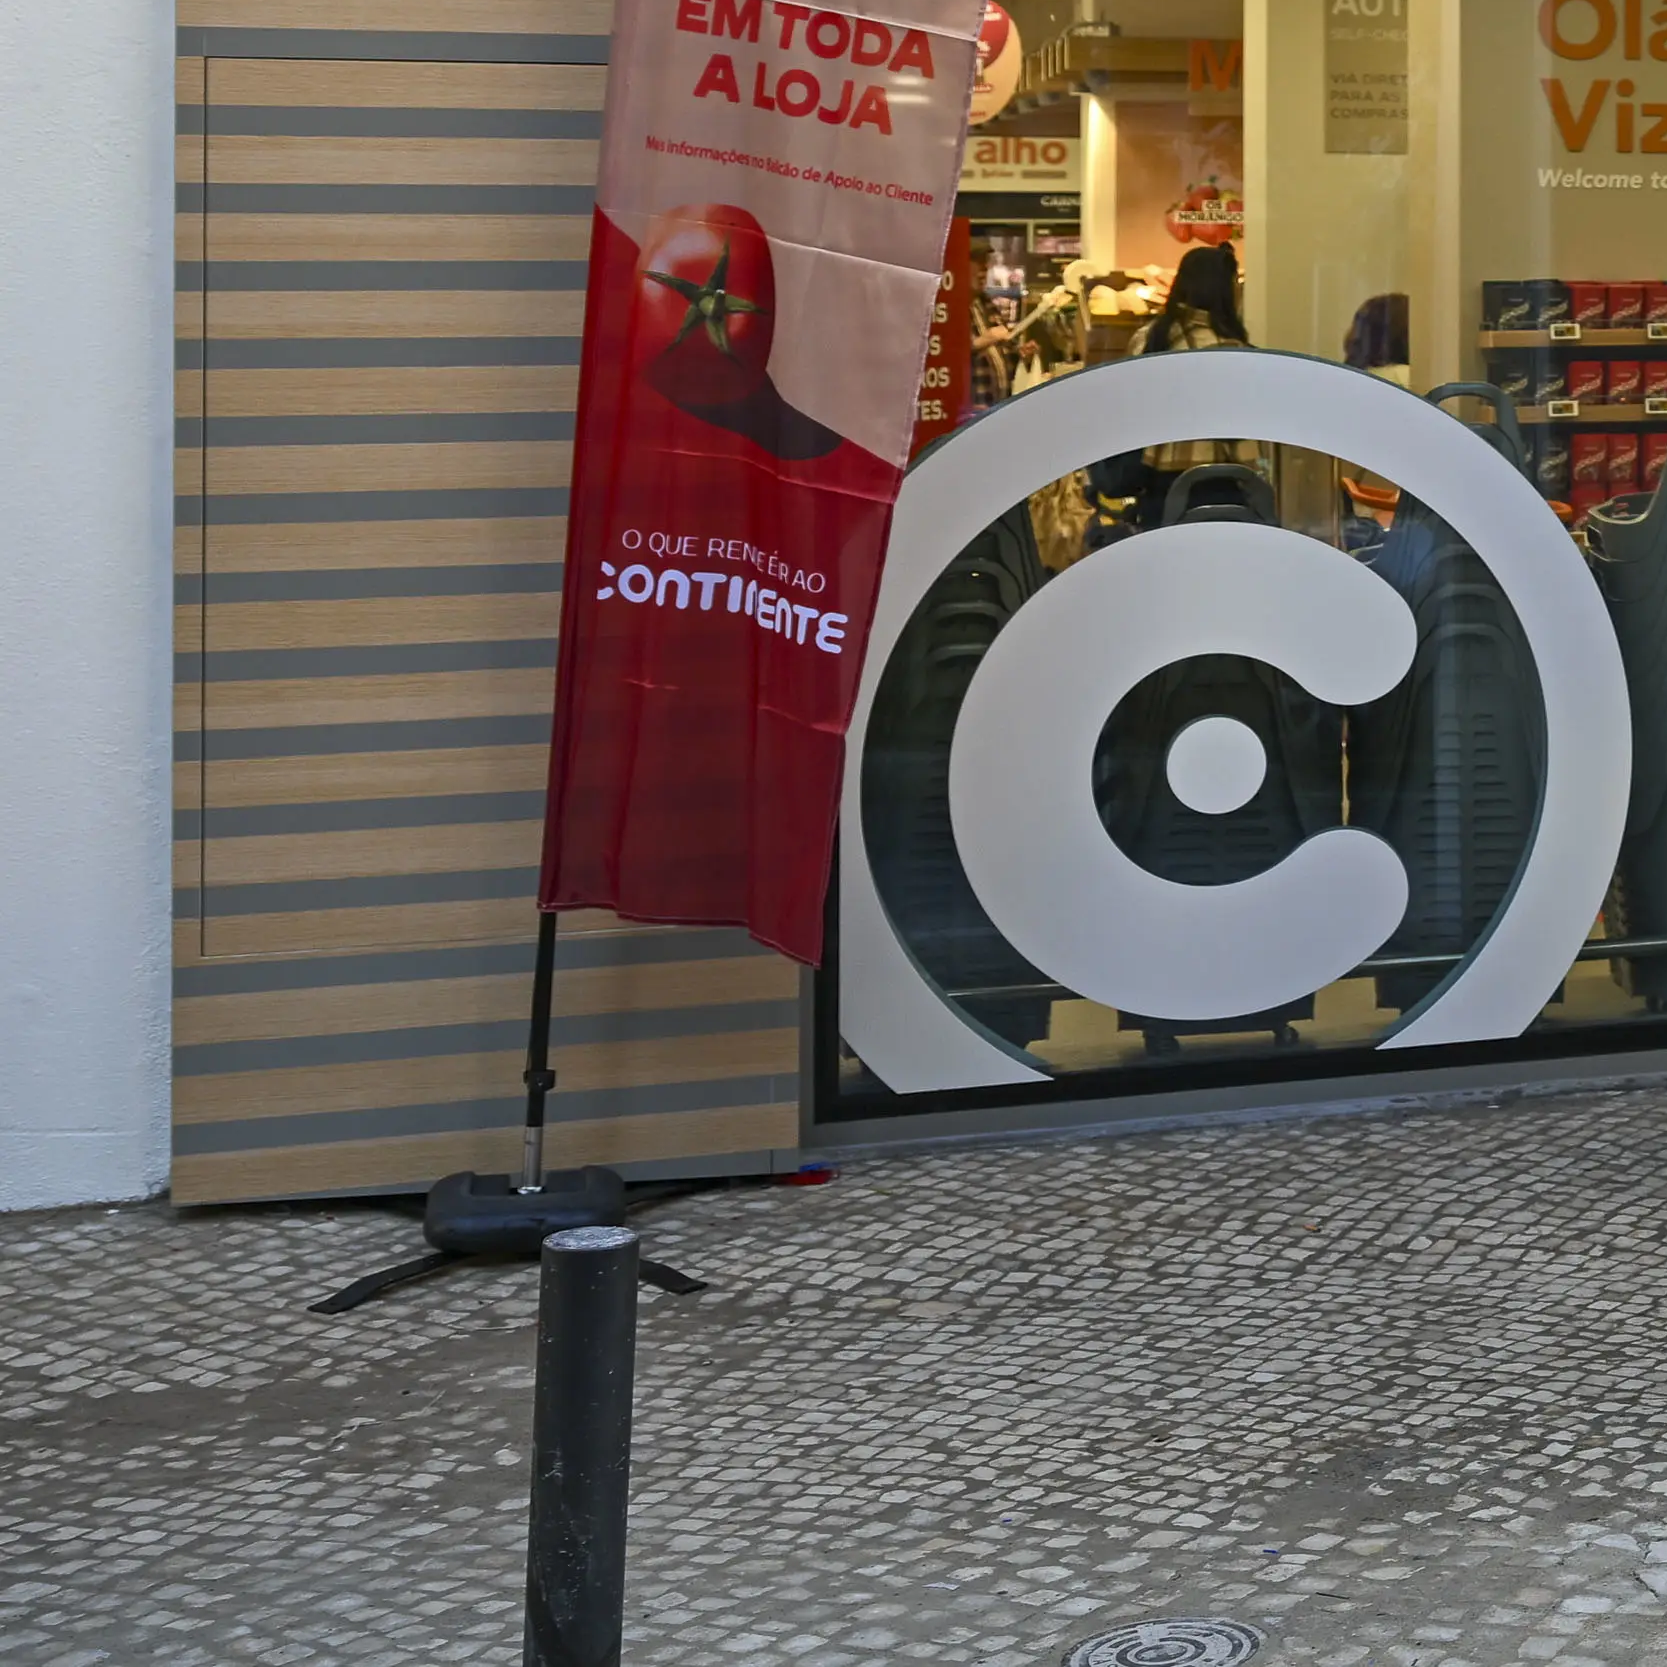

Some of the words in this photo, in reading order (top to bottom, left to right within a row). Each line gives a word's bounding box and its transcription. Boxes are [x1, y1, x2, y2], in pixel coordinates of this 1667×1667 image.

[774, 0, 936, 81] TODA
[692, 54, 741, 104] A
[752, 61, 894, 137] LOJA
[667, 139, 750, 167] informações
[802, 166, 821, 183] de
[824, 170, 863, 191] Apoio
[865, 182, 882, 195] ao
[885, 184, 934, 206] Cliente
[1538, 168, 1644, 189] Welcome
[1178, 212, 1244, 222] MORANGO
[622, 529, 643, 550] O
[649, 532, 699, 559] QUE
